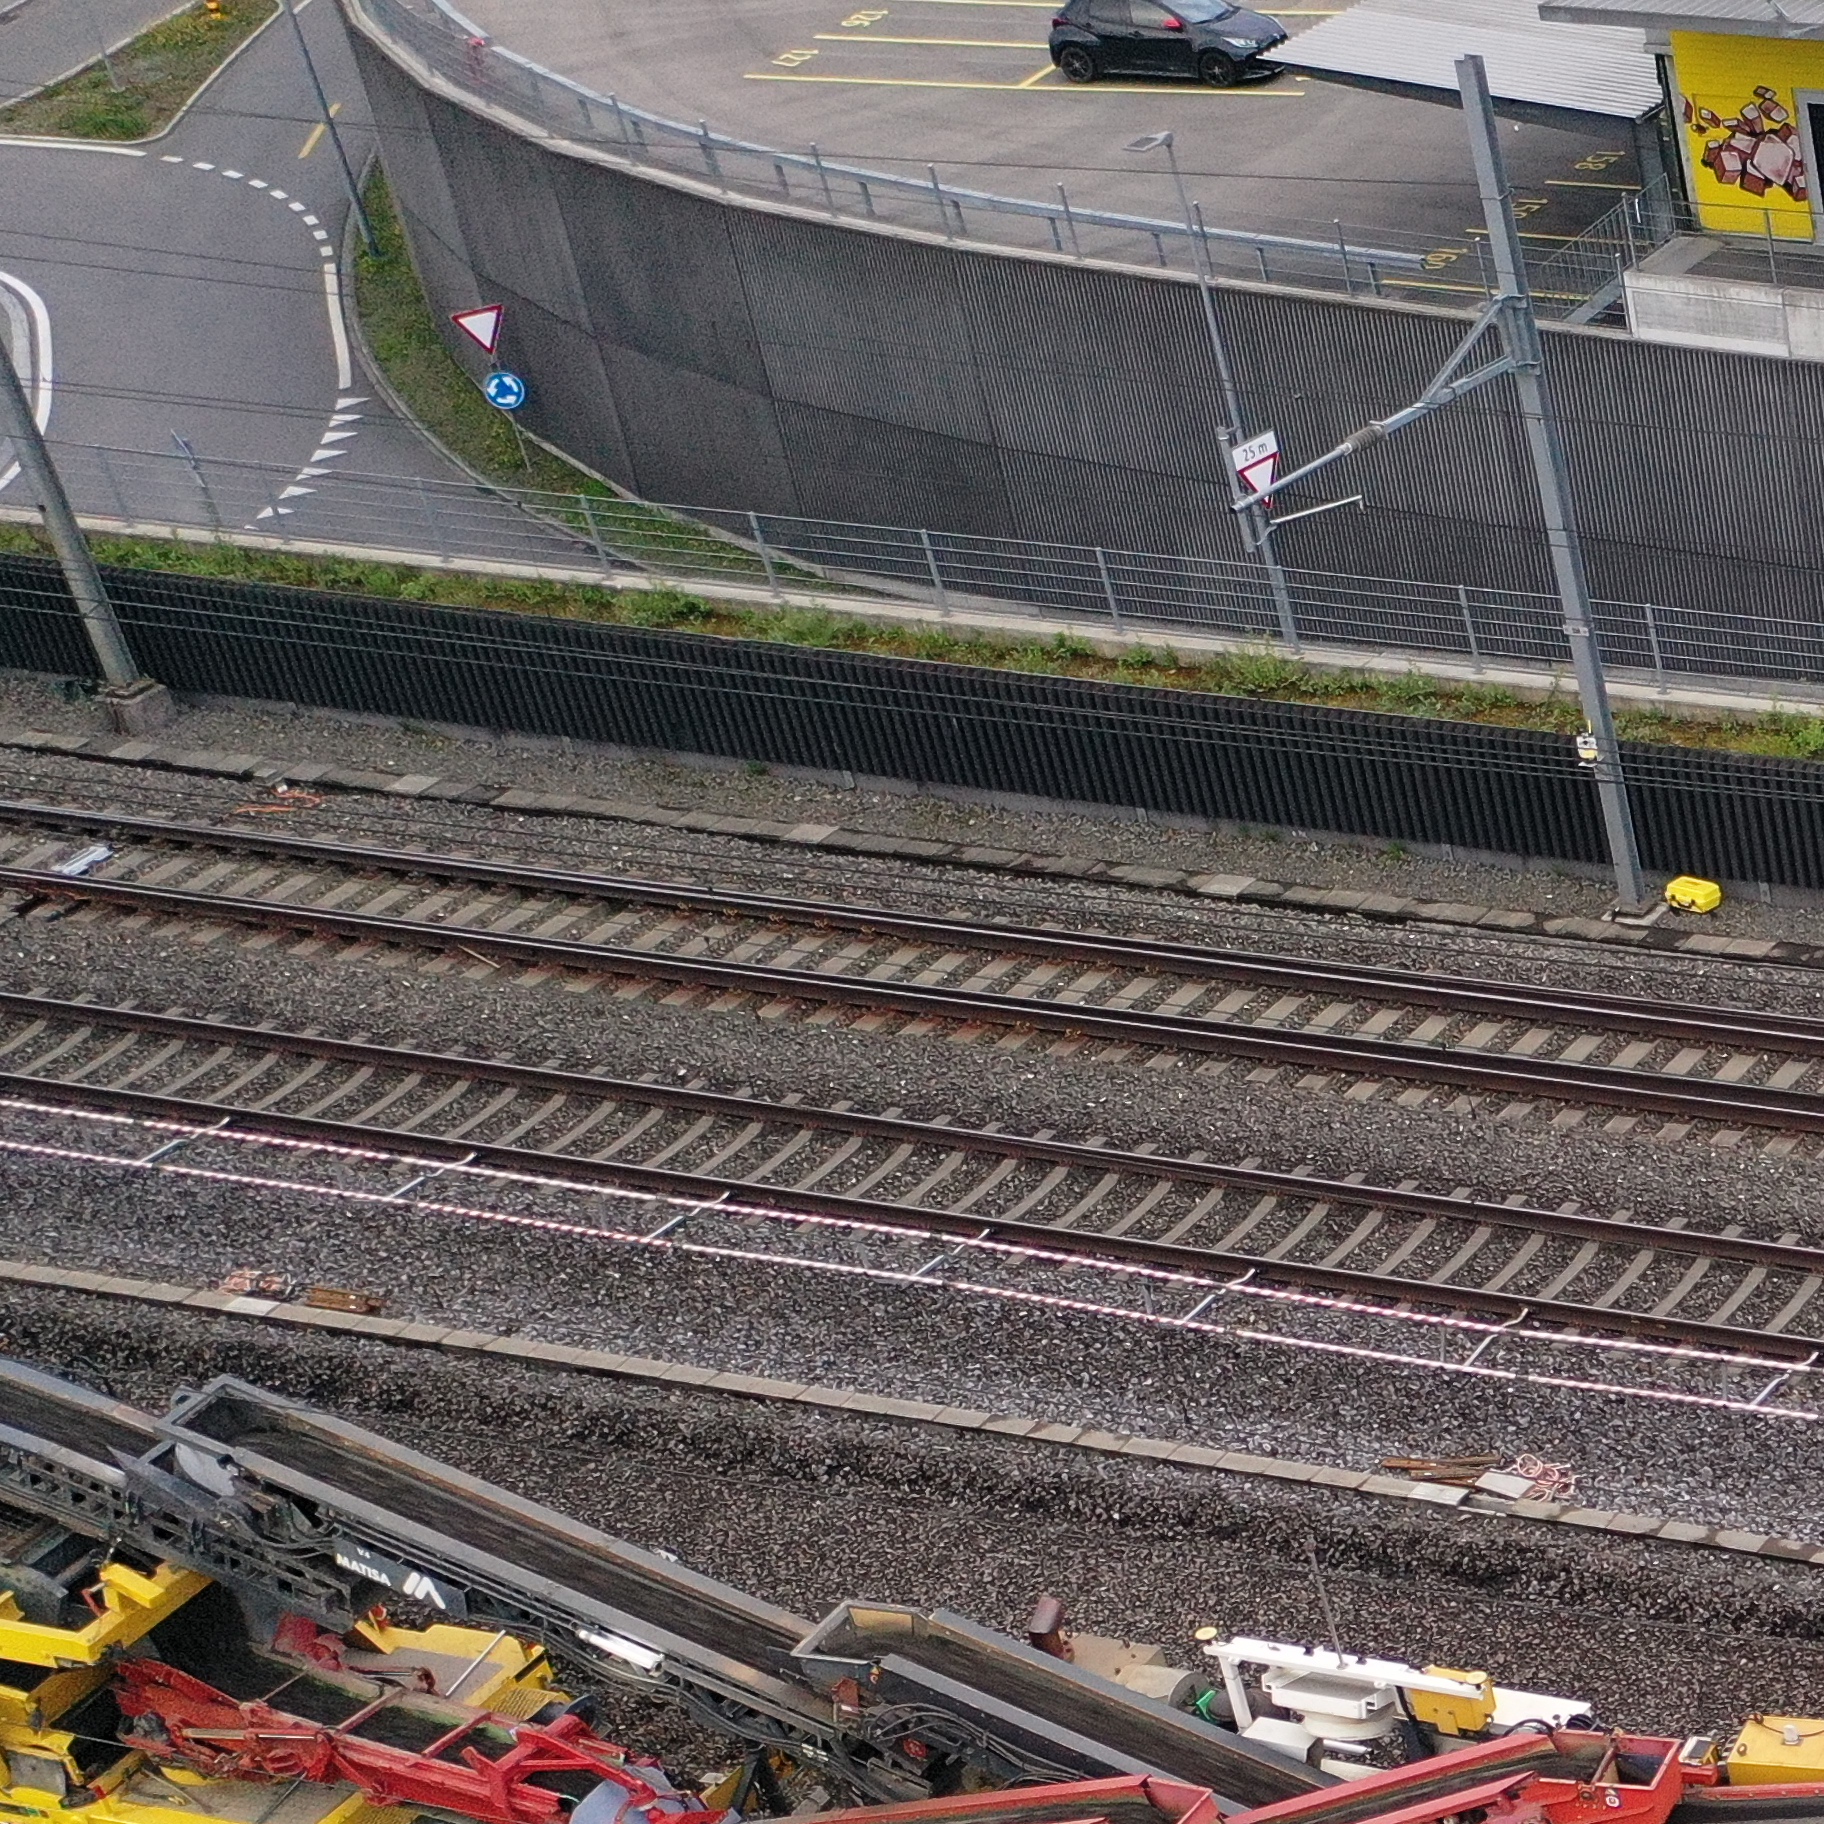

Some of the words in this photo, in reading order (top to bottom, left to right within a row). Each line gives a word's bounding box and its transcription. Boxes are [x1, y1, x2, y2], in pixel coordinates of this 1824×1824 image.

[1242, 445, 1256, 462] 25
[1258, 442, 1268, 455] m
[336, 1552, 392, 1587] MATISA
